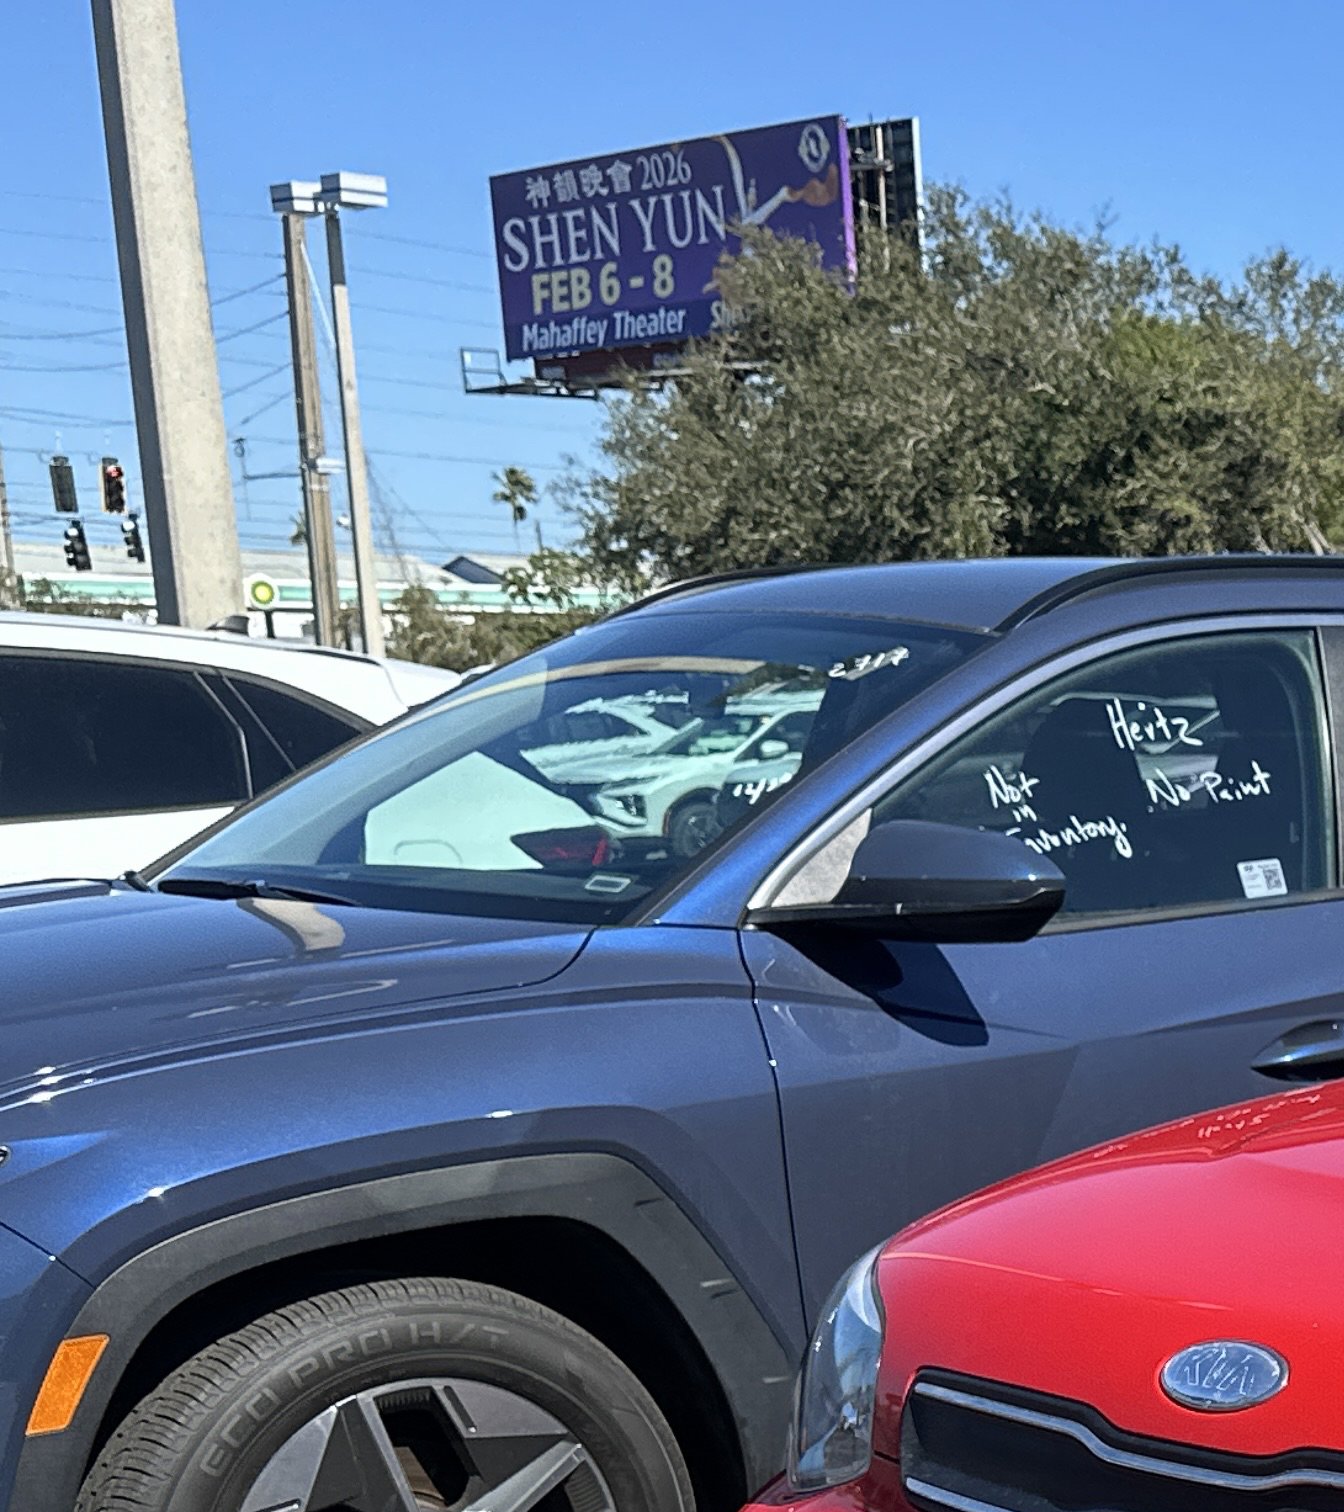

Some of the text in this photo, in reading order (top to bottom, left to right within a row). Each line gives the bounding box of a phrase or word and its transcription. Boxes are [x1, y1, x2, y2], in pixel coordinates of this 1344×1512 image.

[525, 150, 692, 209] 神韻晚會 2026
[502, 184, 728, 273] SHEN YUN
[531, 267, 593, 316] FEB
[600, 261, 621, 306] 6
[652, 253, 675, 299] 8
[522, 315, 608, 352] Mahaffey
[613, 306, 686, 340] Theater
[1106, 697, 1203, 751] Hertz
[983, 764, 1039, 808] Not
[1145, 768, 1192, 806] No
[199, 1386, 282, 1478] ECO
[286, 1328, 393, 1387] PRO
